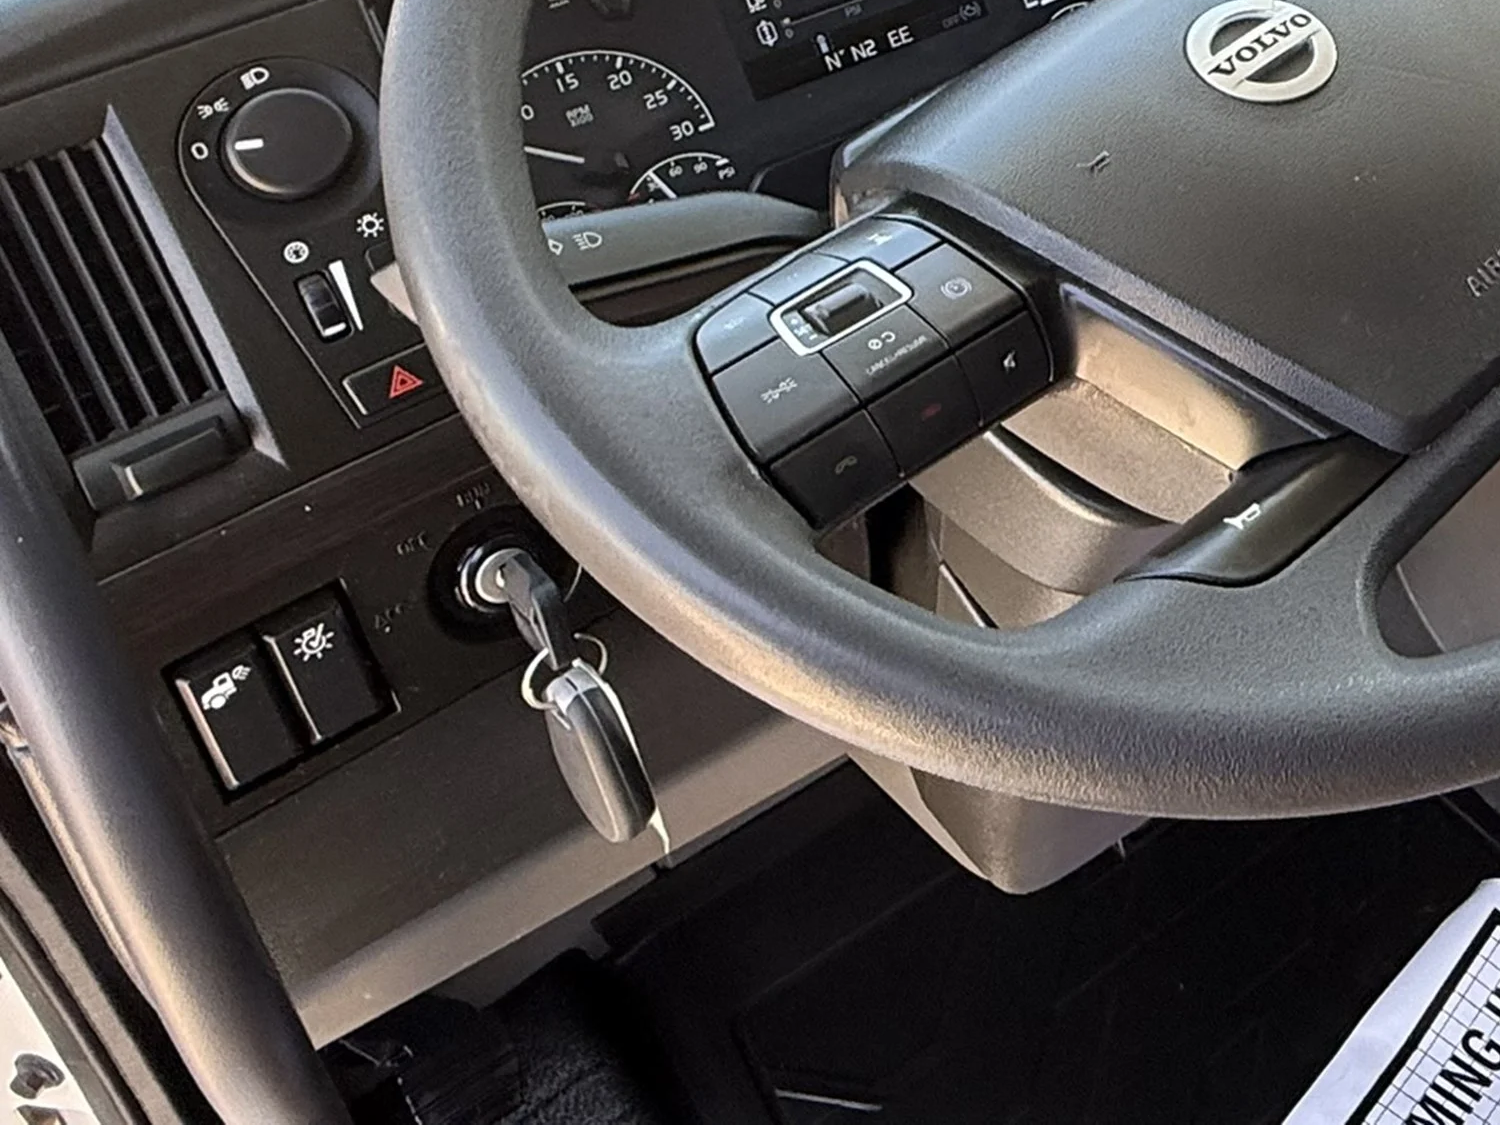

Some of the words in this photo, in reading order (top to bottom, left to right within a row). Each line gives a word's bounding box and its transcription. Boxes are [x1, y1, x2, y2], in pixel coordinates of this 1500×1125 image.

[850, 40, 879, 62] N2
[887, 26, 915, 49] EE
[1207, 12, 1313, 79] VOLVO
[556, 72, 580, 93] 15
[606, 70, 633, 90] 20
[643, 89, 669, 110] 25
[520, 104, 535, 121] 0
[669, 120, 695, 141] 30
